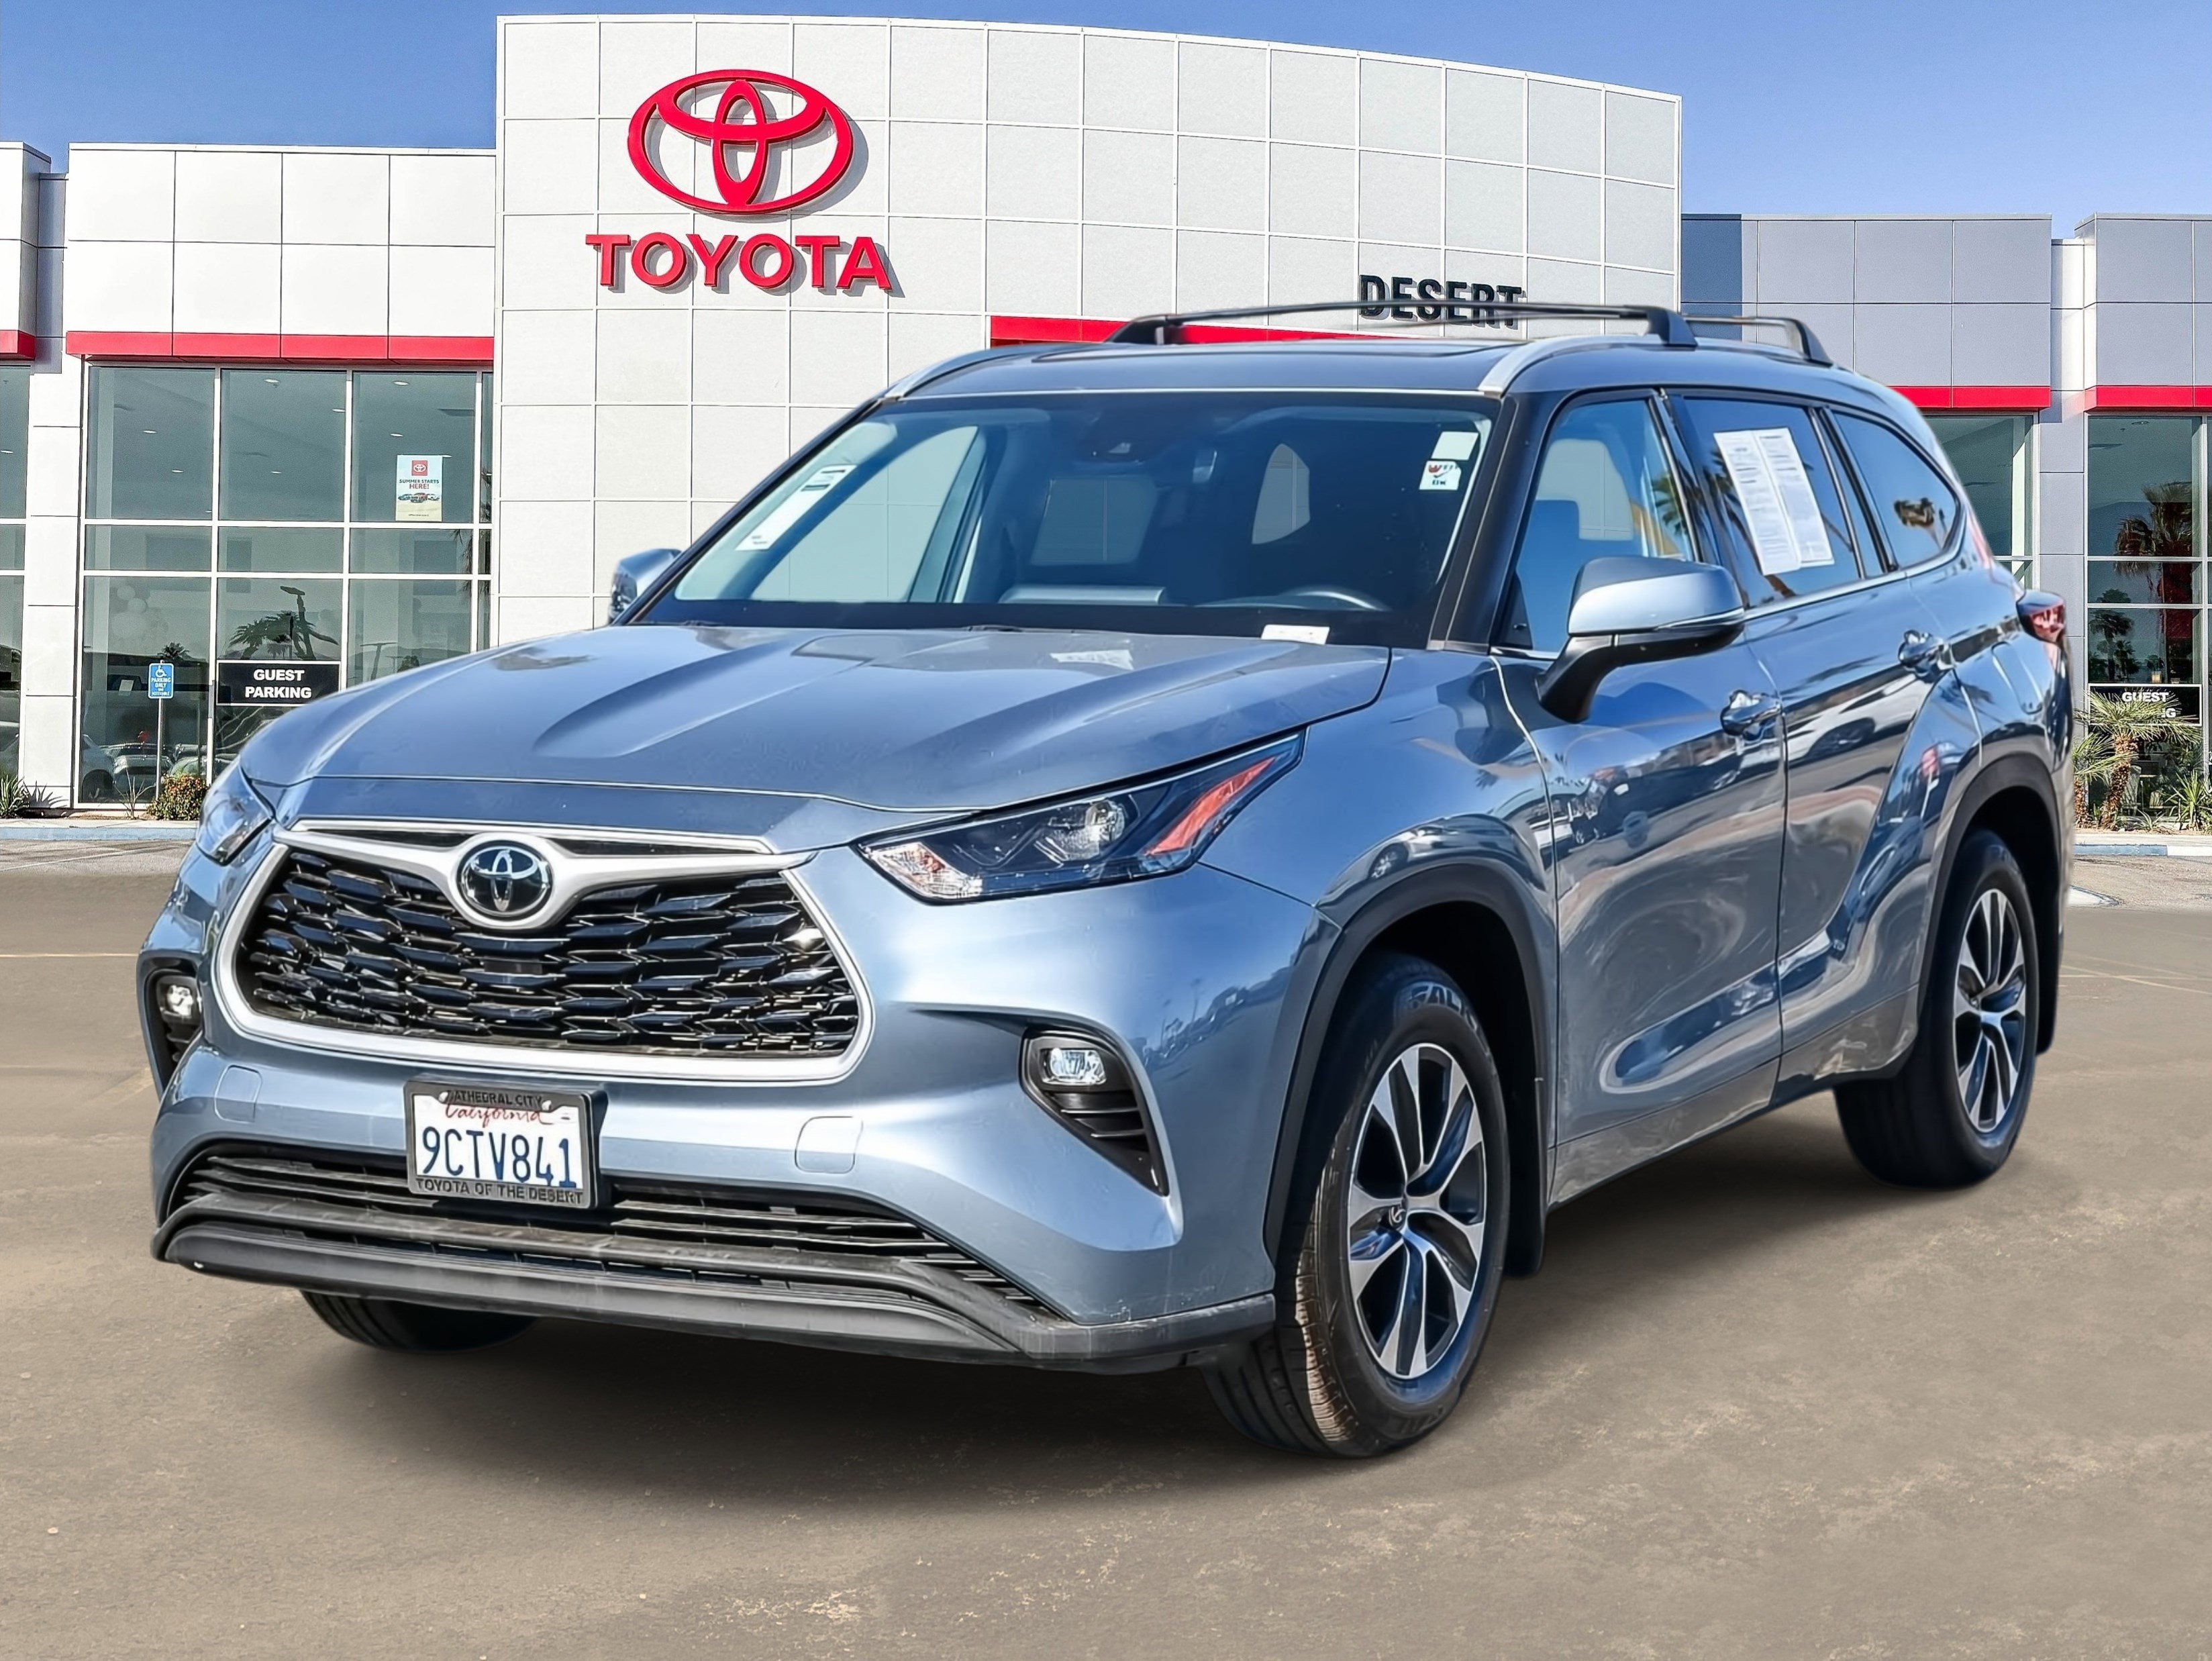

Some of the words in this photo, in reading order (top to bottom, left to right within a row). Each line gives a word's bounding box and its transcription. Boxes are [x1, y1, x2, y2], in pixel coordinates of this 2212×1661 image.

[585, 232, 892, 290] TOYOTA
[1359, 274, 1522, 327] DESERT
[254, 669, 305, 681] GUEST
[245, 687, 311, 699] PARKING
[2121, 691, 2170, 703] GUEST
[515, 1094, 543, 1107] CITY
[423, 1126, 577, 1188] 9CTV841
[415, 1178, 470, 1194] TOYOTA
[474, 1182, 493, 1195] OF
[497, 1184, 526, 1199] THE
[528, 1187, 583, 1205] DESERT
